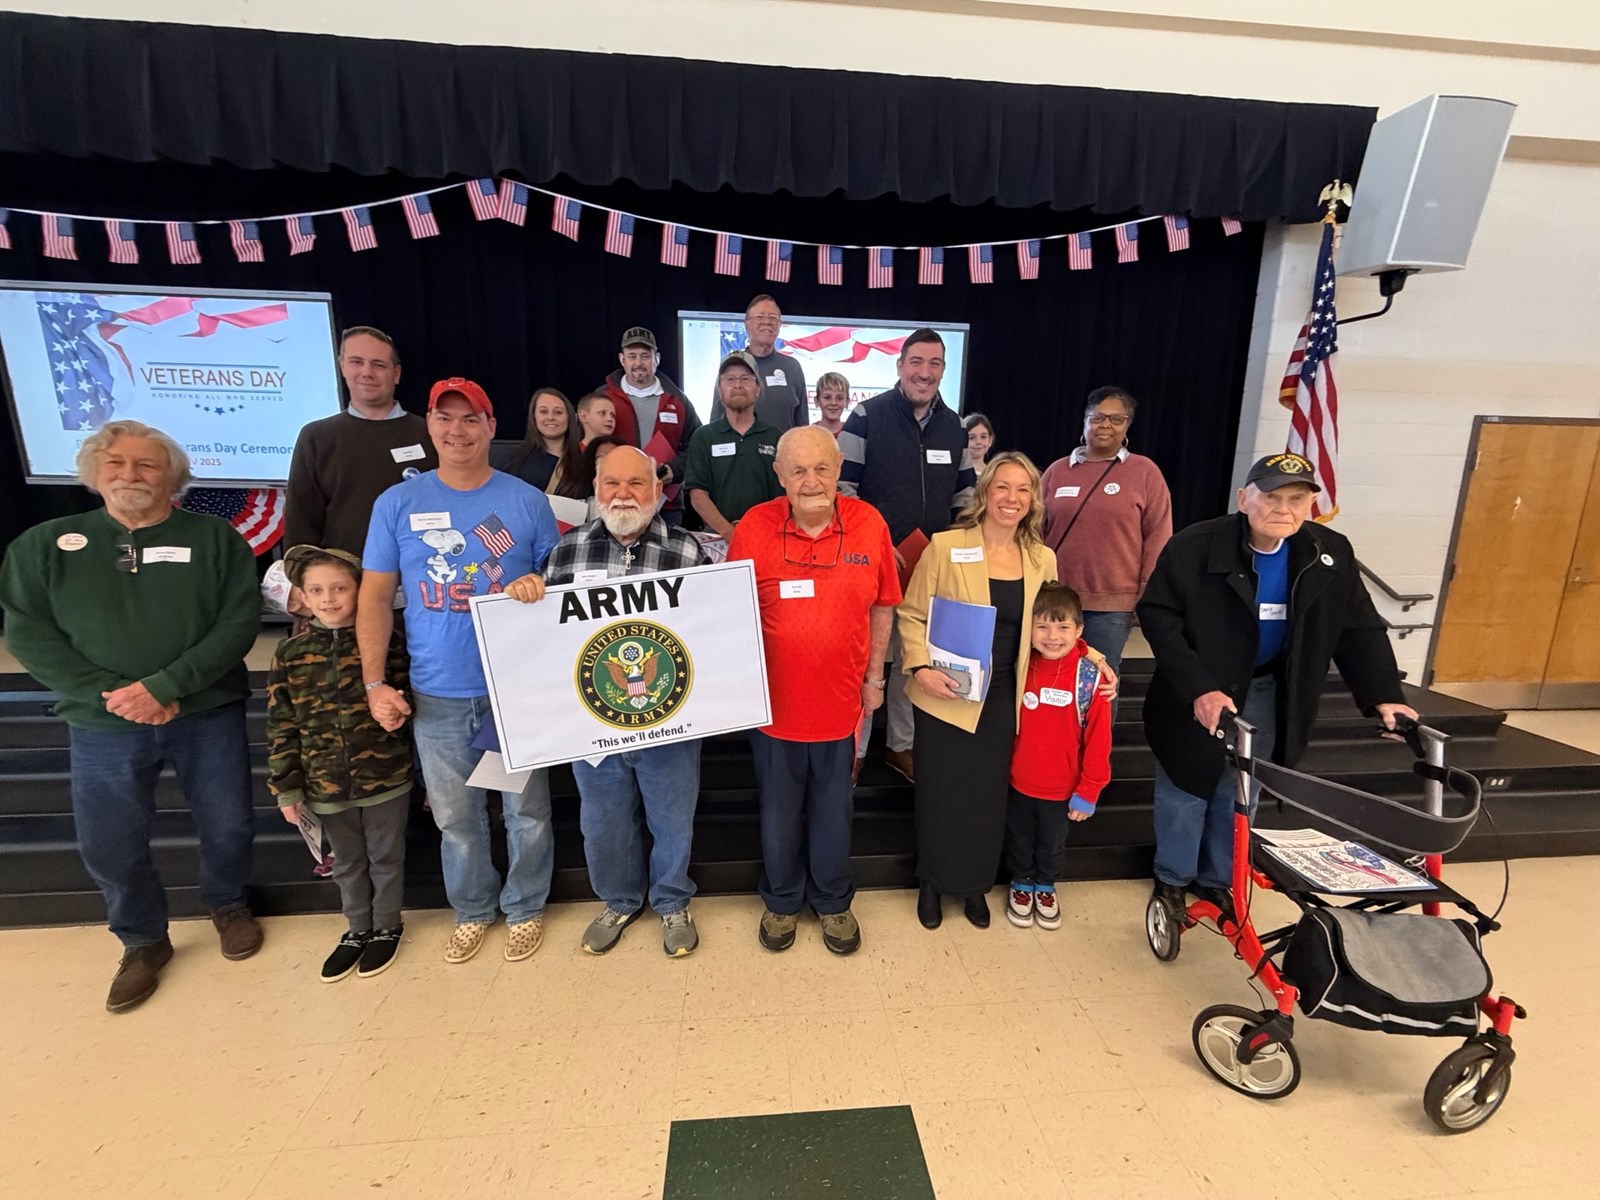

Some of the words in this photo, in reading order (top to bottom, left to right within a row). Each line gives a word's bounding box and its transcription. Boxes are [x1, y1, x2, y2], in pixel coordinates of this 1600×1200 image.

[627, 328, 652, 340] ARMY
[140, 367, 245, 387] VETERANS
[250, 371, 287, 388] DAY
[151, 392, 201, 400] HONORING
[185, 444, 212, 453] rans
[214, 442, 238, 456] Day
[200, 458, 223, 466] 2025
[843, 553, 870, 566] USA
[559, 576, 684, 625] ARMY
[584, 626, 627, 667] UNITED
[630, 626, 679, 655] STATES
[1044, 694, 1067, 705] Visitor
[616, 705, 666, 724] ARMY
[592, 738, 620, 749] “This
[621, 731, 646, 745] we’ll
[648, 723, 693, 740] defend.”
